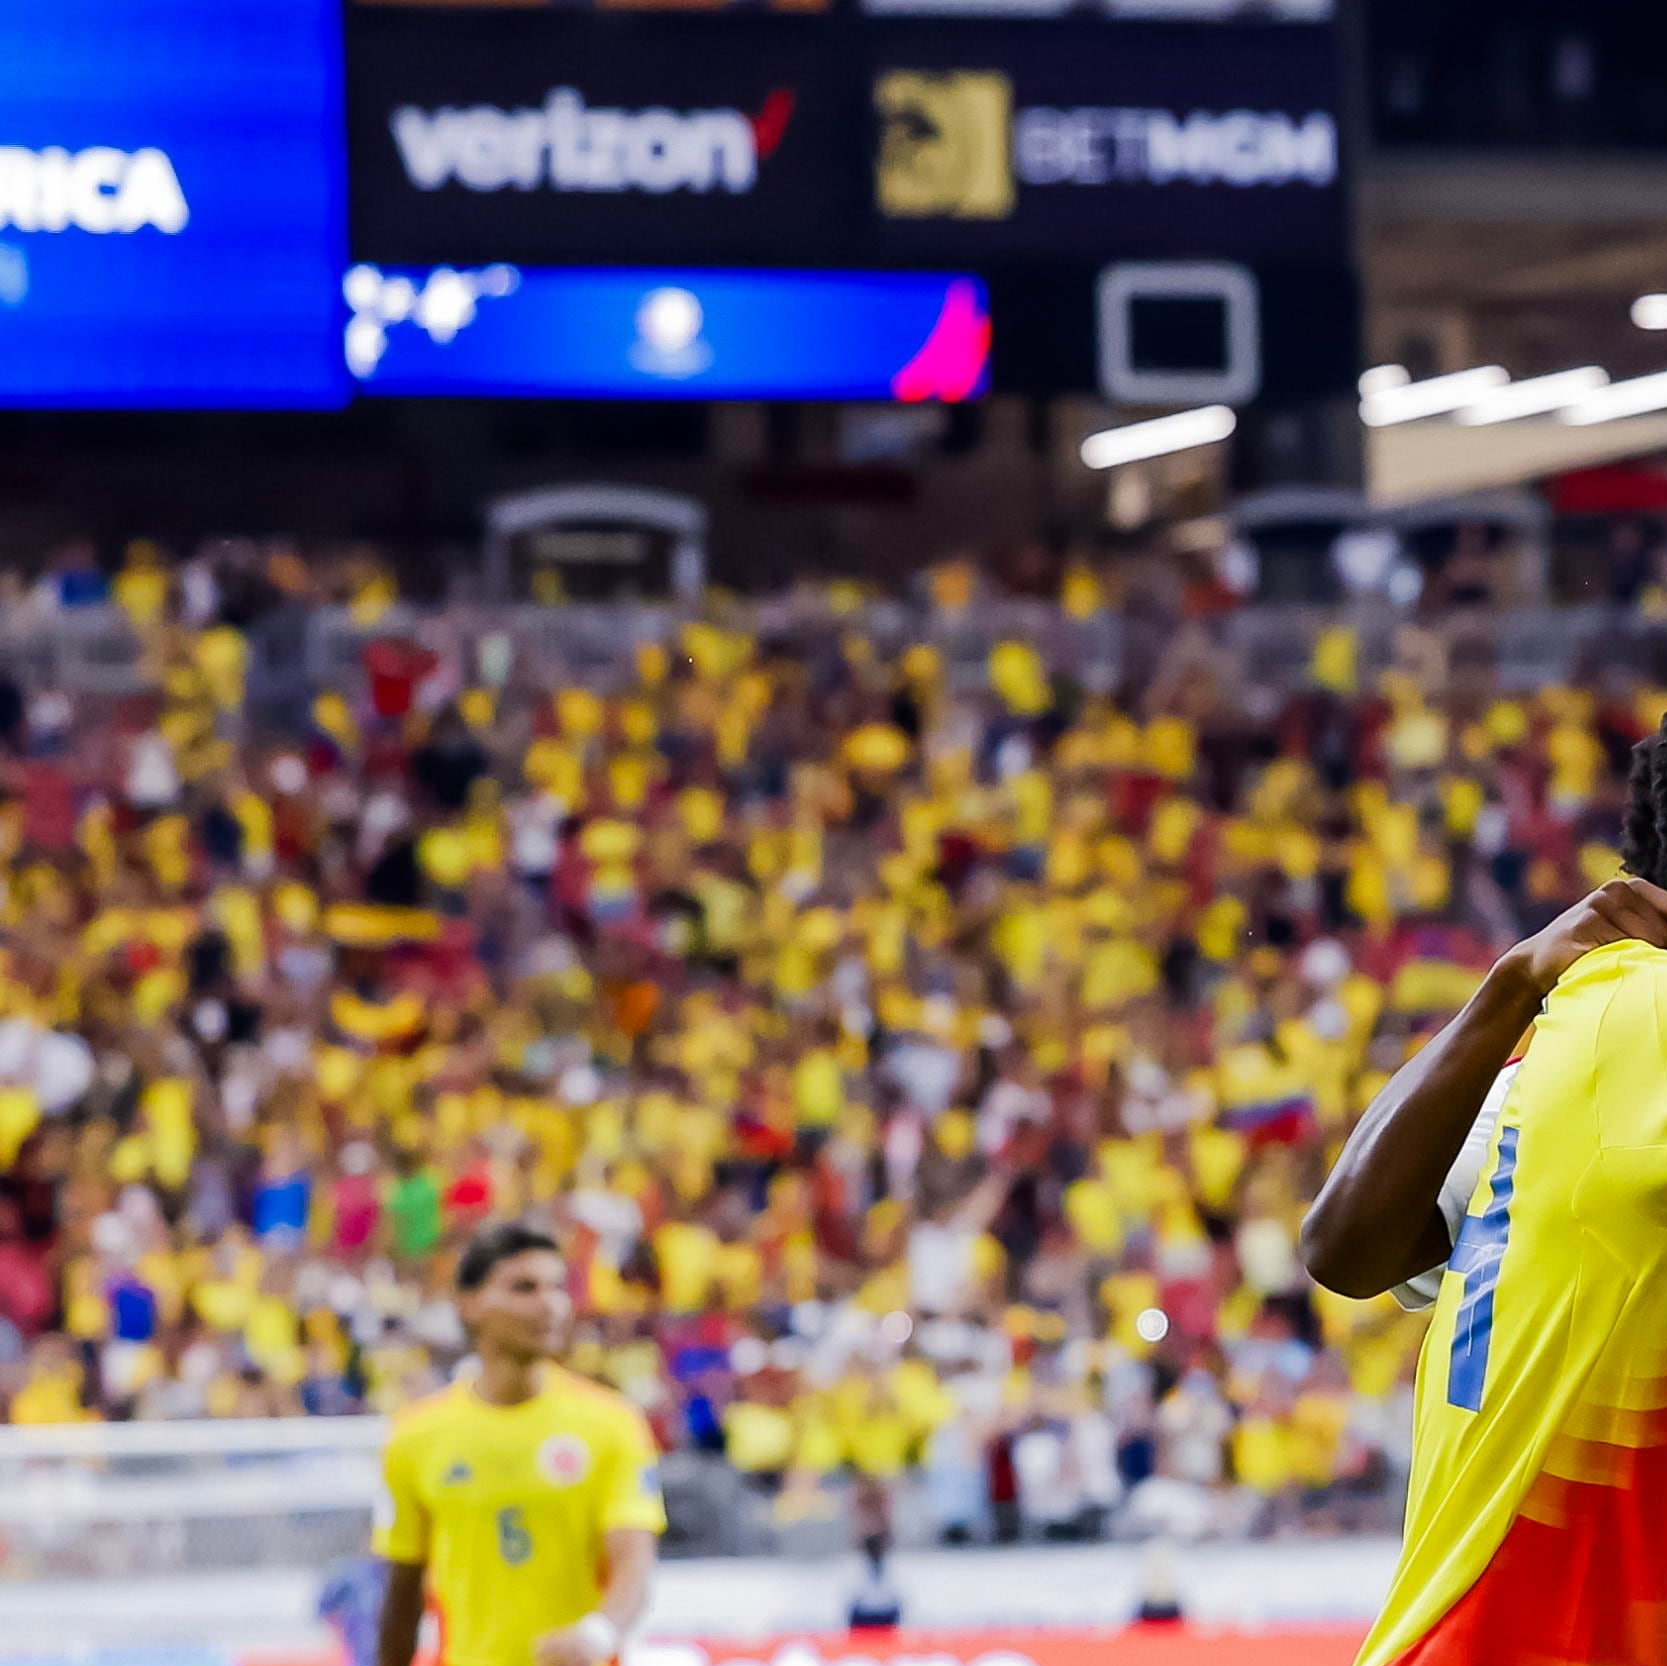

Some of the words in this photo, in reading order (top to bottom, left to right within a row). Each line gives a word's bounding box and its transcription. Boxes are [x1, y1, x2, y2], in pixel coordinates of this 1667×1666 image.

[390, 85, 757, 194] verizon
[1015, 106, 1338, 188] BETMGM
[496, 1507, 533, 1567] 6
